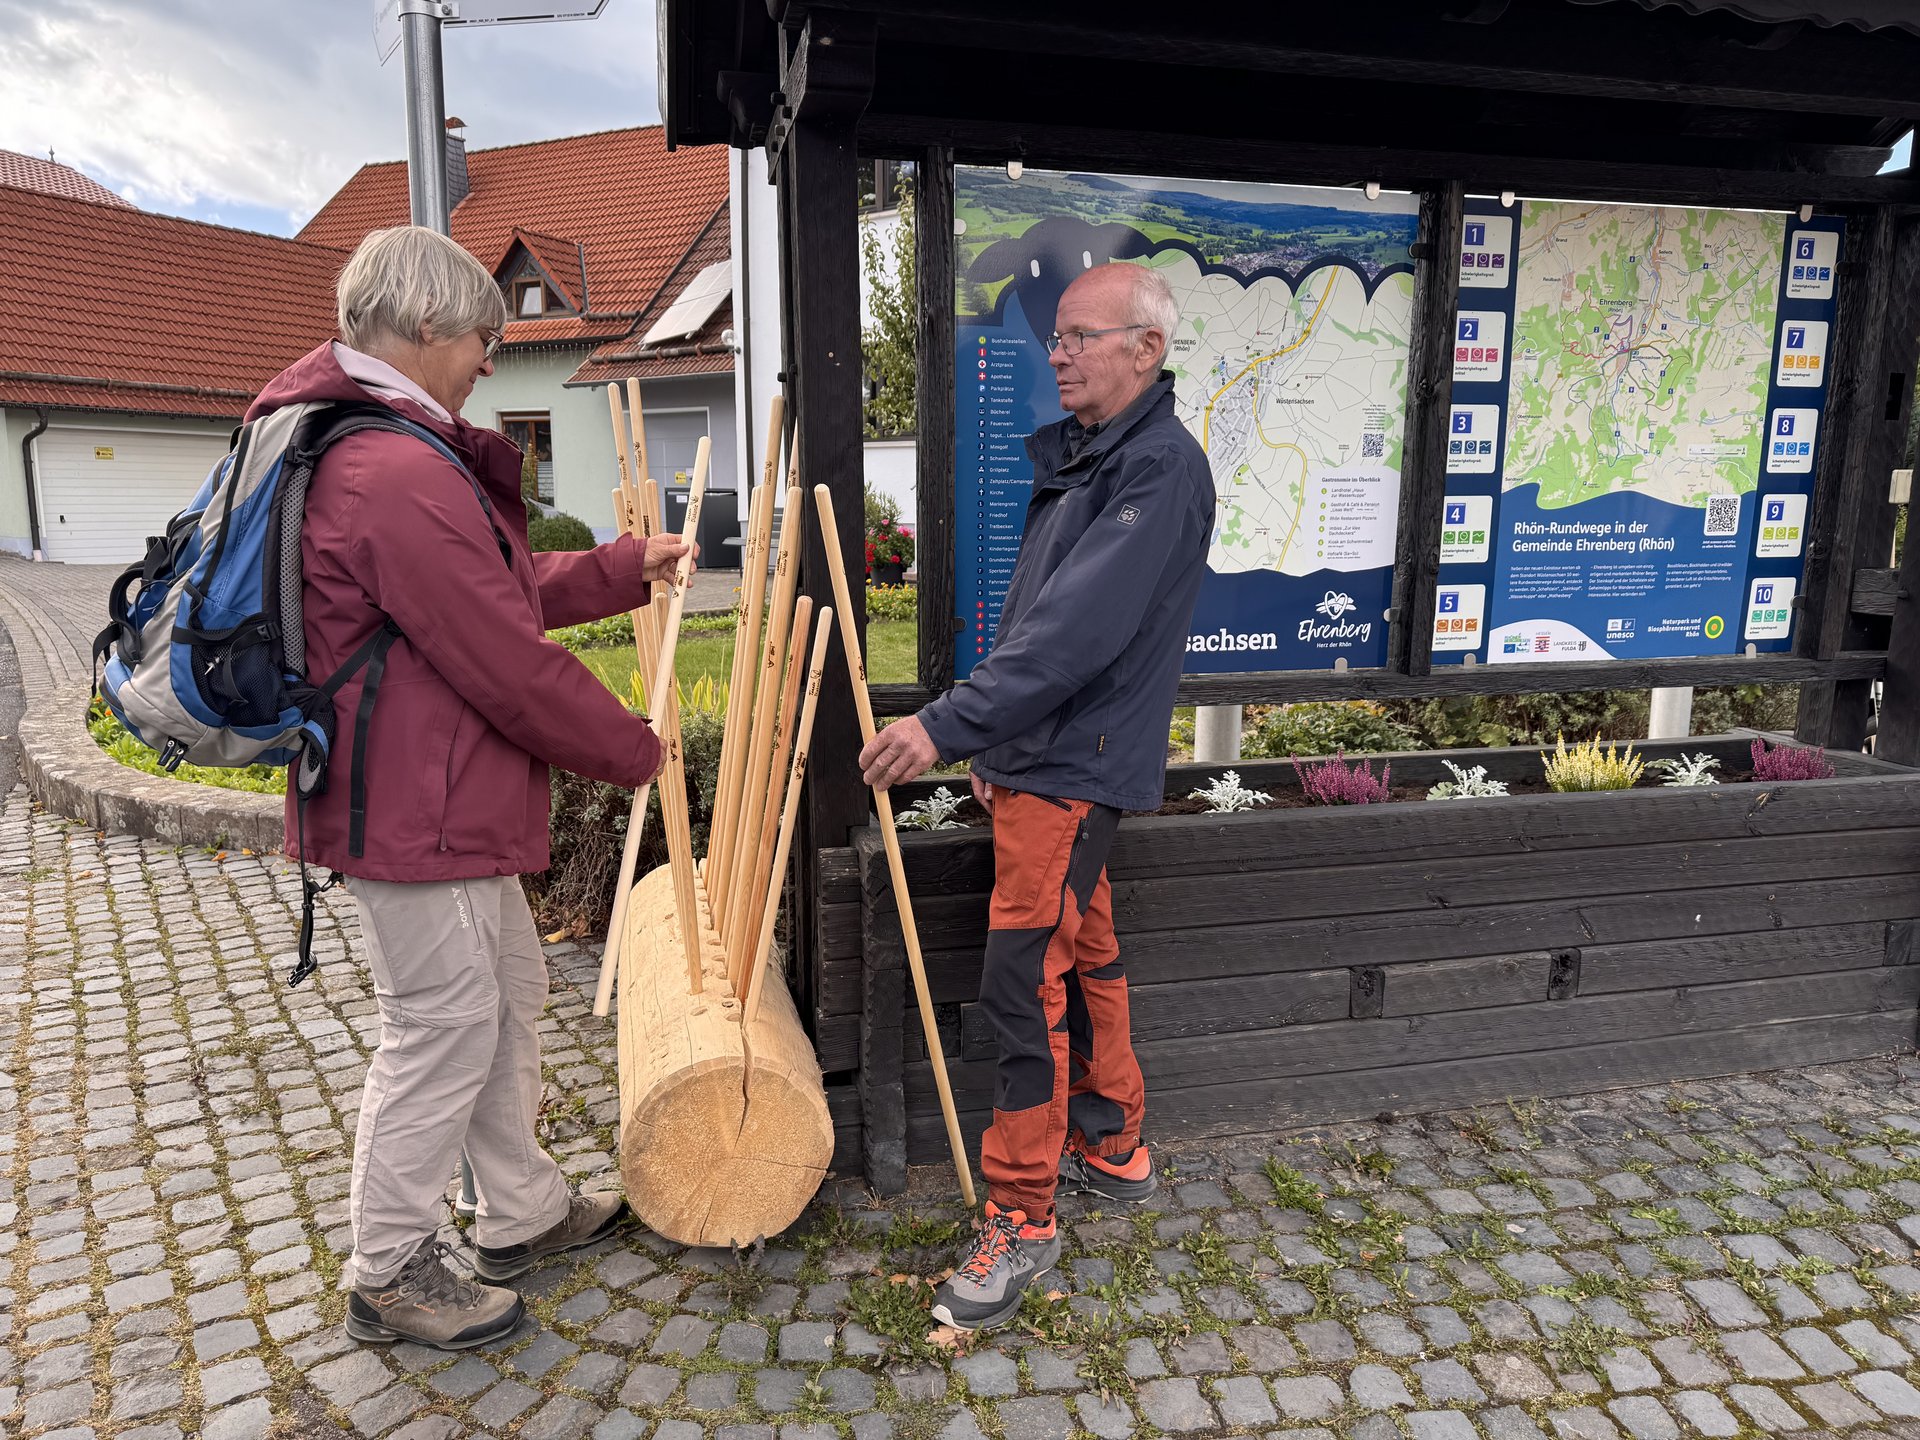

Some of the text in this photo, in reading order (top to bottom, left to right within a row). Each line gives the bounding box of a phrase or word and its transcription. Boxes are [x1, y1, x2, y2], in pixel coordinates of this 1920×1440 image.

[1472, 228, 1478, 242] 1
[1802, 243, 1809, 256] 6
[1464, 323, 1472, 337] 2
[1792, 332, 1800, 346] 7
[1458, 416, 1466, 431] 3
[1782, 420, 1789, 433] 8
[1451, 508, 1460, 522] 4
[1772, 505, 1779, 518] 9
[1514, 521, 1648, 536] Rhön-Rundwege in der
[1512, 537, 1675, 553] Gemeinde Ehrenberg (Rhön)
[1757, 588, 1771, 601] 10
[1444, 596, 1453, 610] 5
[1298, 619, 1372, 642] Ehrenberg
[1185, 628, 1277, 652] sachsen
[456, 898, 469, 928] VAUDE
